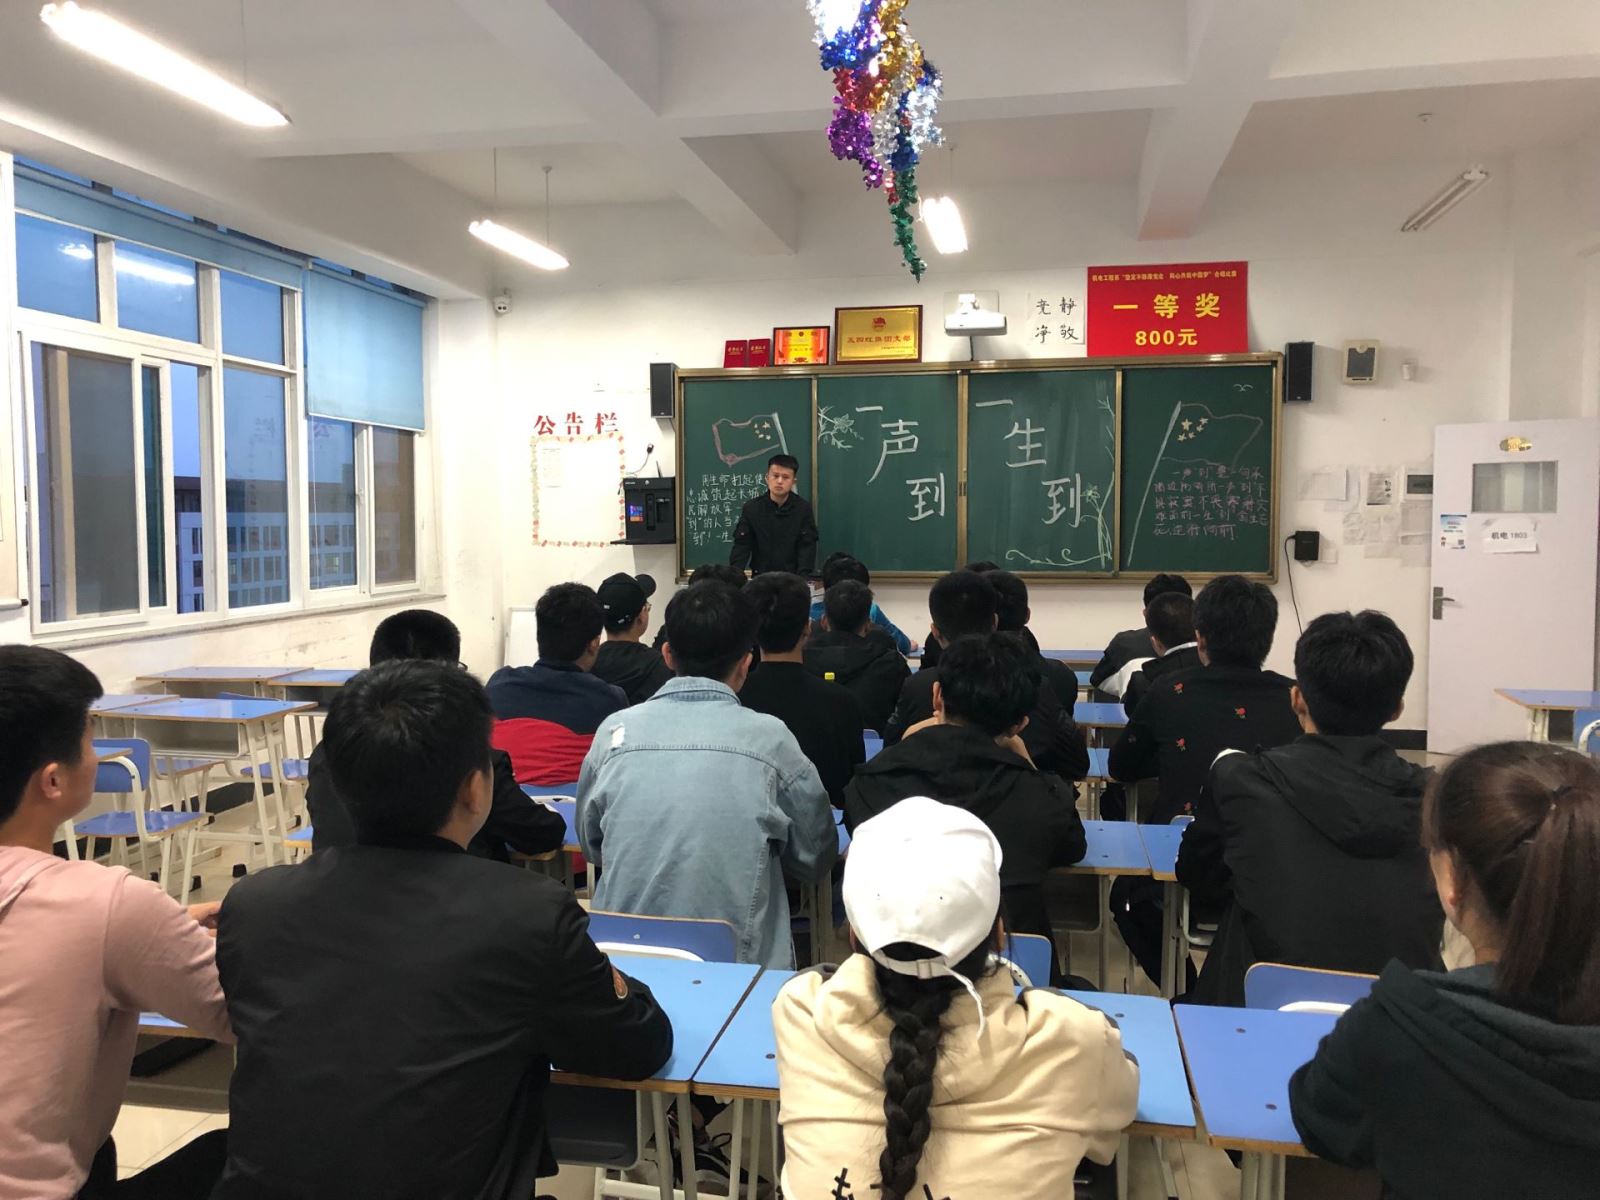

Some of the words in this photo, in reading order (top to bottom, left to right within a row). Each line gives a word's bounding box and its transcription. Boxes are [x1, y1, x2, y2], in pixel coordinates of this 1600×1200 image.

[1113, 292, 1220, 319] 一等奖
[1135, 328, 1198, 346] 800元
[533, 411, 619, 436] 公告栏
[688, 502, 746, 516] 民解放军一
